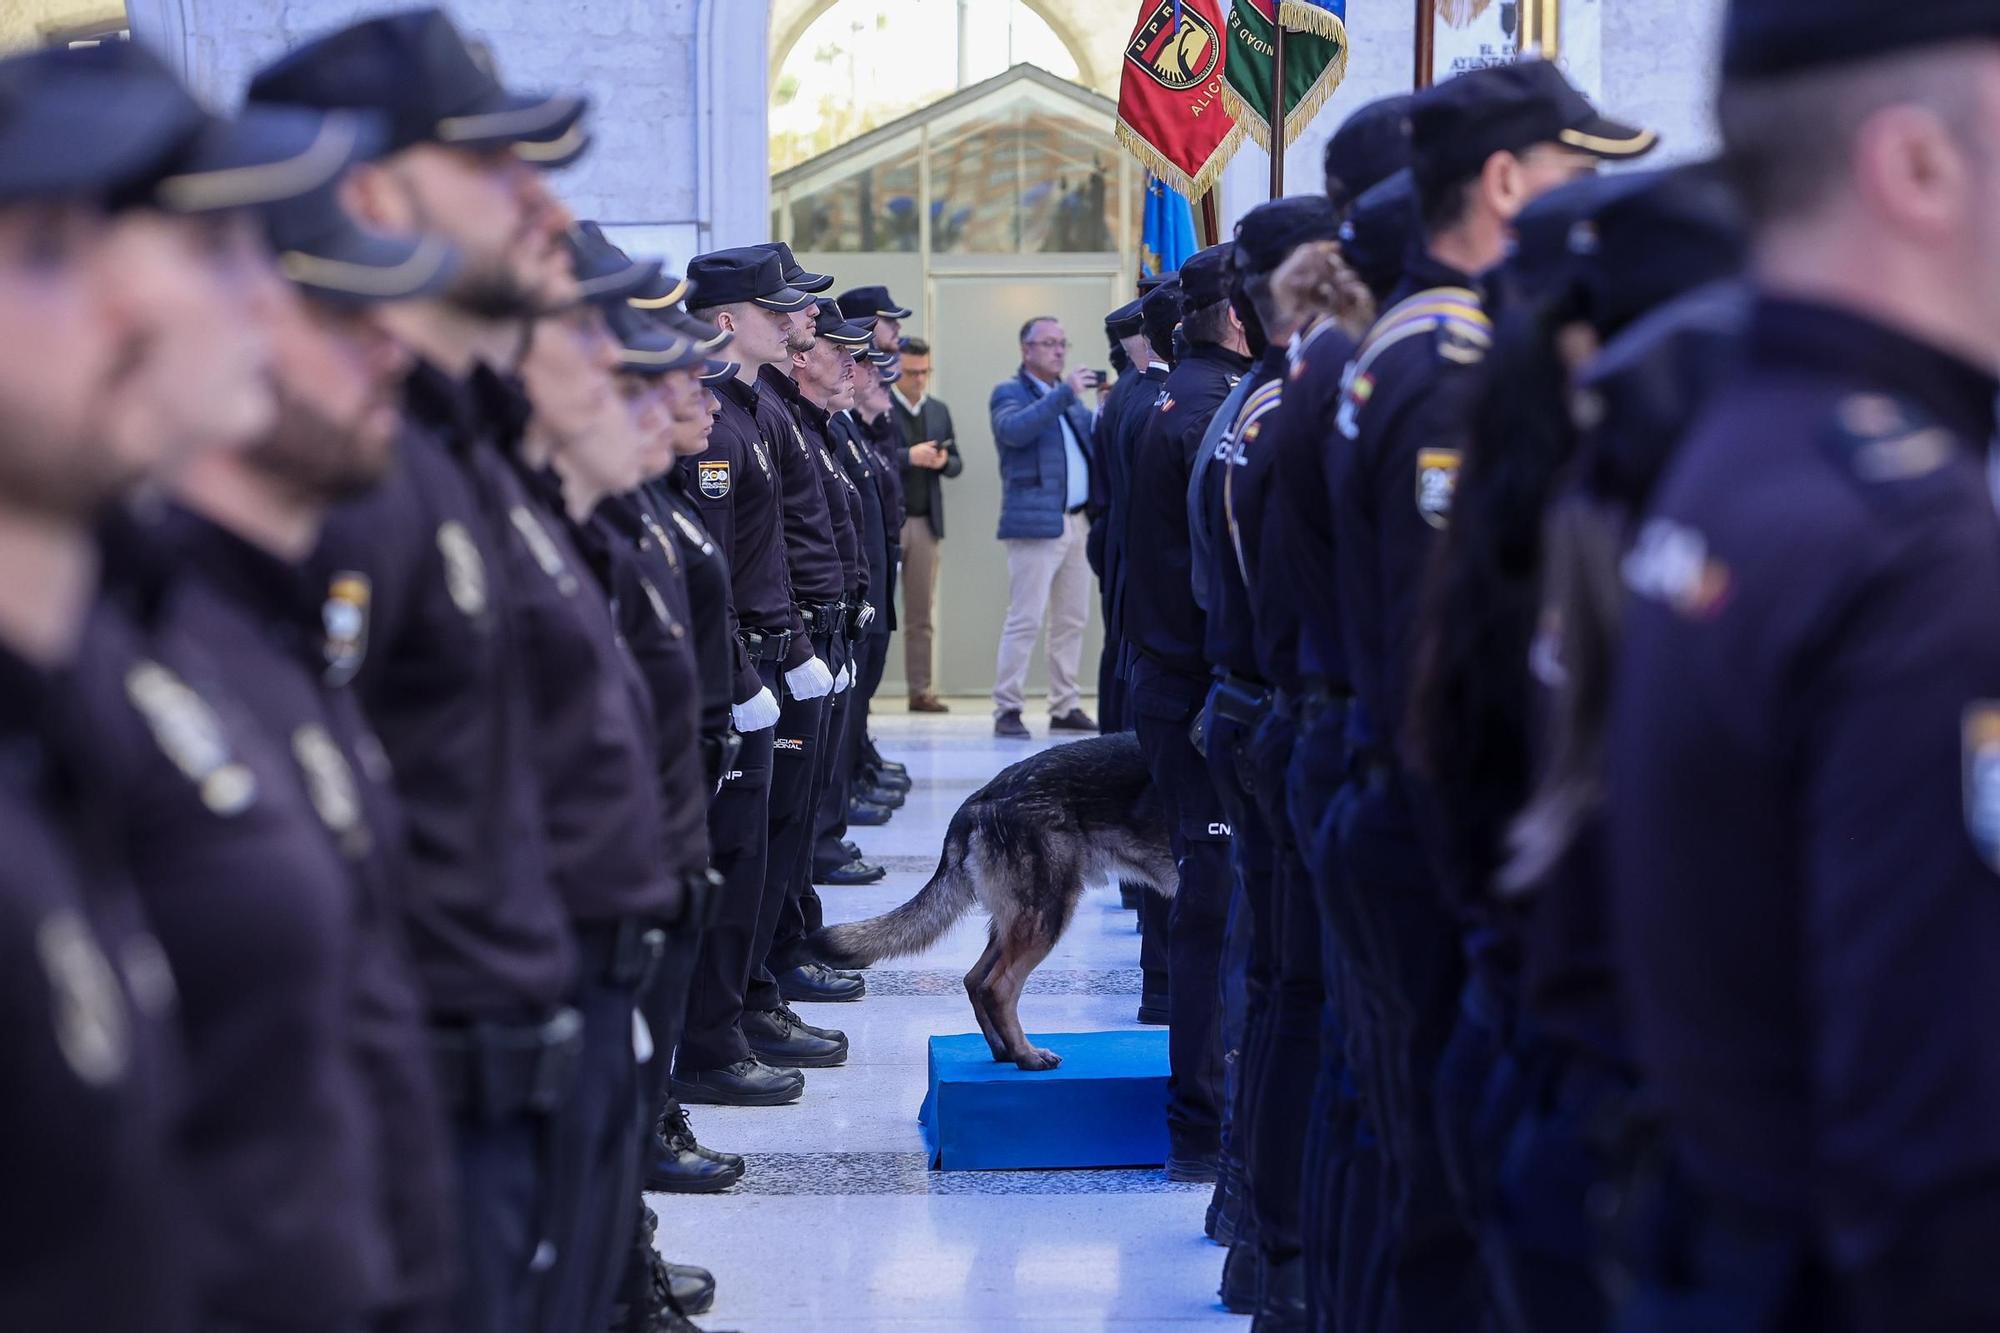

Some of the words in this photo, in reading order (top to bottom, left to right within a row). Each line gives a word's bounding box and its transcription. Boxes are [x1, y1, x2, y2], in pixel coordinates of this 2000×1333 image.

[1229, 6, 1241, 29] ES
[1239, 28, 1274, 56] NIDAD
[1191, 66, 1225, 117] ALICA
[725, 770, 743, 780] NP
[1208, 823, 1233, 835] CN
